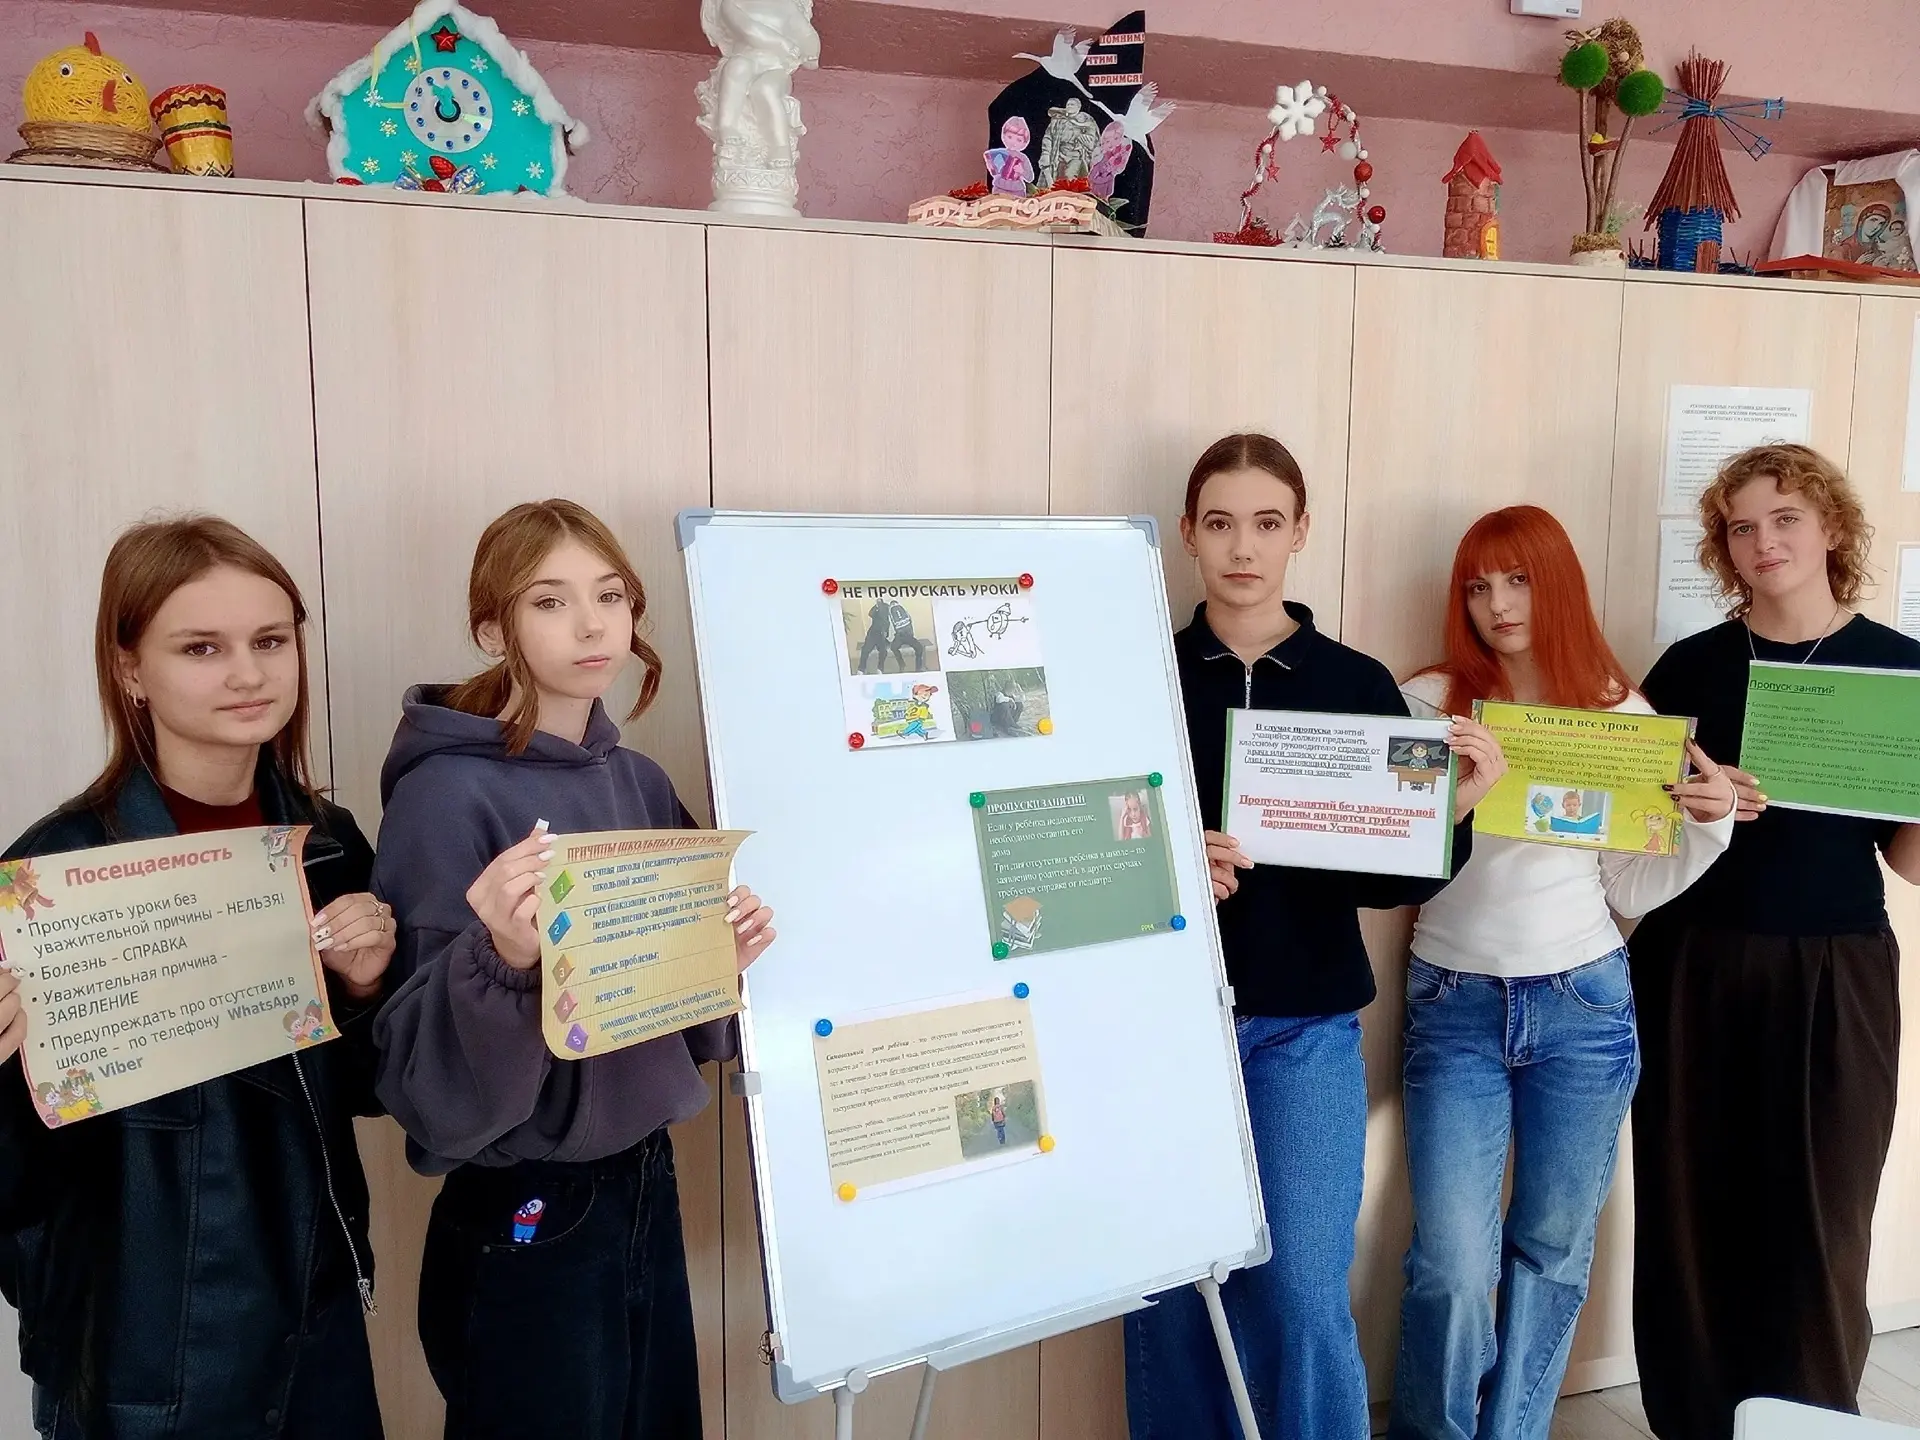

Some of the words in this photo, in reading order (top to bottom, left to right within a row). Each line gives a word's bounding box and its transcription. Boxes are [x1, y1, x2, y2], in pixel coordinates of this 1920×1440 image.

[1100, 34, 1144, 44] ПОМНИМ!
[1086, 56, 1116, 64] ЧТИМ!
[1089, 74, 1142, 84] ГОРДИМСЯ!
[920, 201, 980, 226] 1941
[1008, 198, 1077, 220] 1945
[842, 587, 862, 598] НЕ
[868, 585, 966, 598] ПРОПУСКАТЬ
[972, 584, 1020, 596] УРОКИ
[1750, 680, 1792, 691] Пропуск
[1794, 684, 1836, 694] занятий
[1524, 713, 1554, 724] Ходи
[1600, 722, 1640, 732] уроки
[1239, 740, 1278, 749] классному
[1338, 746, 1370, 754] справку
[1291, 735, 1321, 743] должен
[987, 801, 1040, 813] ПРОПУСКИ
[1042, 795, 1086, 808] ЗАНЯТИЙ
[1239, 794, 1290, 808] Пропуски
[1293, 798, 1336, 810] занятий
[1339, 802, 1354, 810] без
[1358, 804, 1436, 818] уважительной
[1262, 808, 1311, 820] причины
[1314, 812, 1366, 823] являются
[1368, 814, 1410, 826] грубым
[987, 822, 1006, 832] Если
[1072, 828, 1084, 836] его
[1261, 819, 1327, 832] нарушением
[1330, 822, 1366, 834] Устава
[1369, 827, 1410, 838] школы.
[992, 849, 1011, 858] дома
[65, 846, 232, 886] Посещаемость
[584, 864, 615, 879] скучная
[616, 860, 640, 874] школа
[560, 884, 565, 894] 1
[592, 877, 630, 892] школьной
[584, 903, 606, 918] страх
[608, 896, 648, 914] (наказание
[648, 895, 657, 904] со
[658, 889, 687, 904] стороны
[688, 885, 714, 900] учителя
[650, 906, 678, 919] задание
[680, 902, 693, 912] или
[28, 908, 124, 938] Пропускать
[127, 898, 171, 921] уроки
[174, 893, 198, 908] без
[34, 922, 150, 958] уважительной
[154, 909, 213, 932] причины
[226, 893, 286, 916] НЕЛЬЗЯ!
[554, 924, 560, 935] 2
[636, 923, 662, 938] других
[41, 957, 107, 981] Болезнь
[122, 937, 188, 962] СПРАВКА
[620, 952, 660, 970] проблемы;
[44, 970, 158, 1005] Уважительная
[161, 954, 218, 978] причина
[559, 967, 565, 978] 3
[594, 986, 636, 1004] депрессия;
[46, 991, 140, 1026] ЗАЯВЛЕНИЕ
[50, 1009, 177, 1051] Предупреждать
[180, 999, 206, 1018] про
[208, 978, 285, 1010] отсутствии
[288, 975, 296, 986] в
[562, 1000, 568, 1012] 4
[56, 1045, 108, 1070] школе
[128, 1034, 148, 1050] по
[150, 1014, 220, 1044] телефону
[228, 992, 300, 1022] WhatsApp
[573, 1035, 582, 1046] 5
[98, 1056, 144, 1078] Viber
